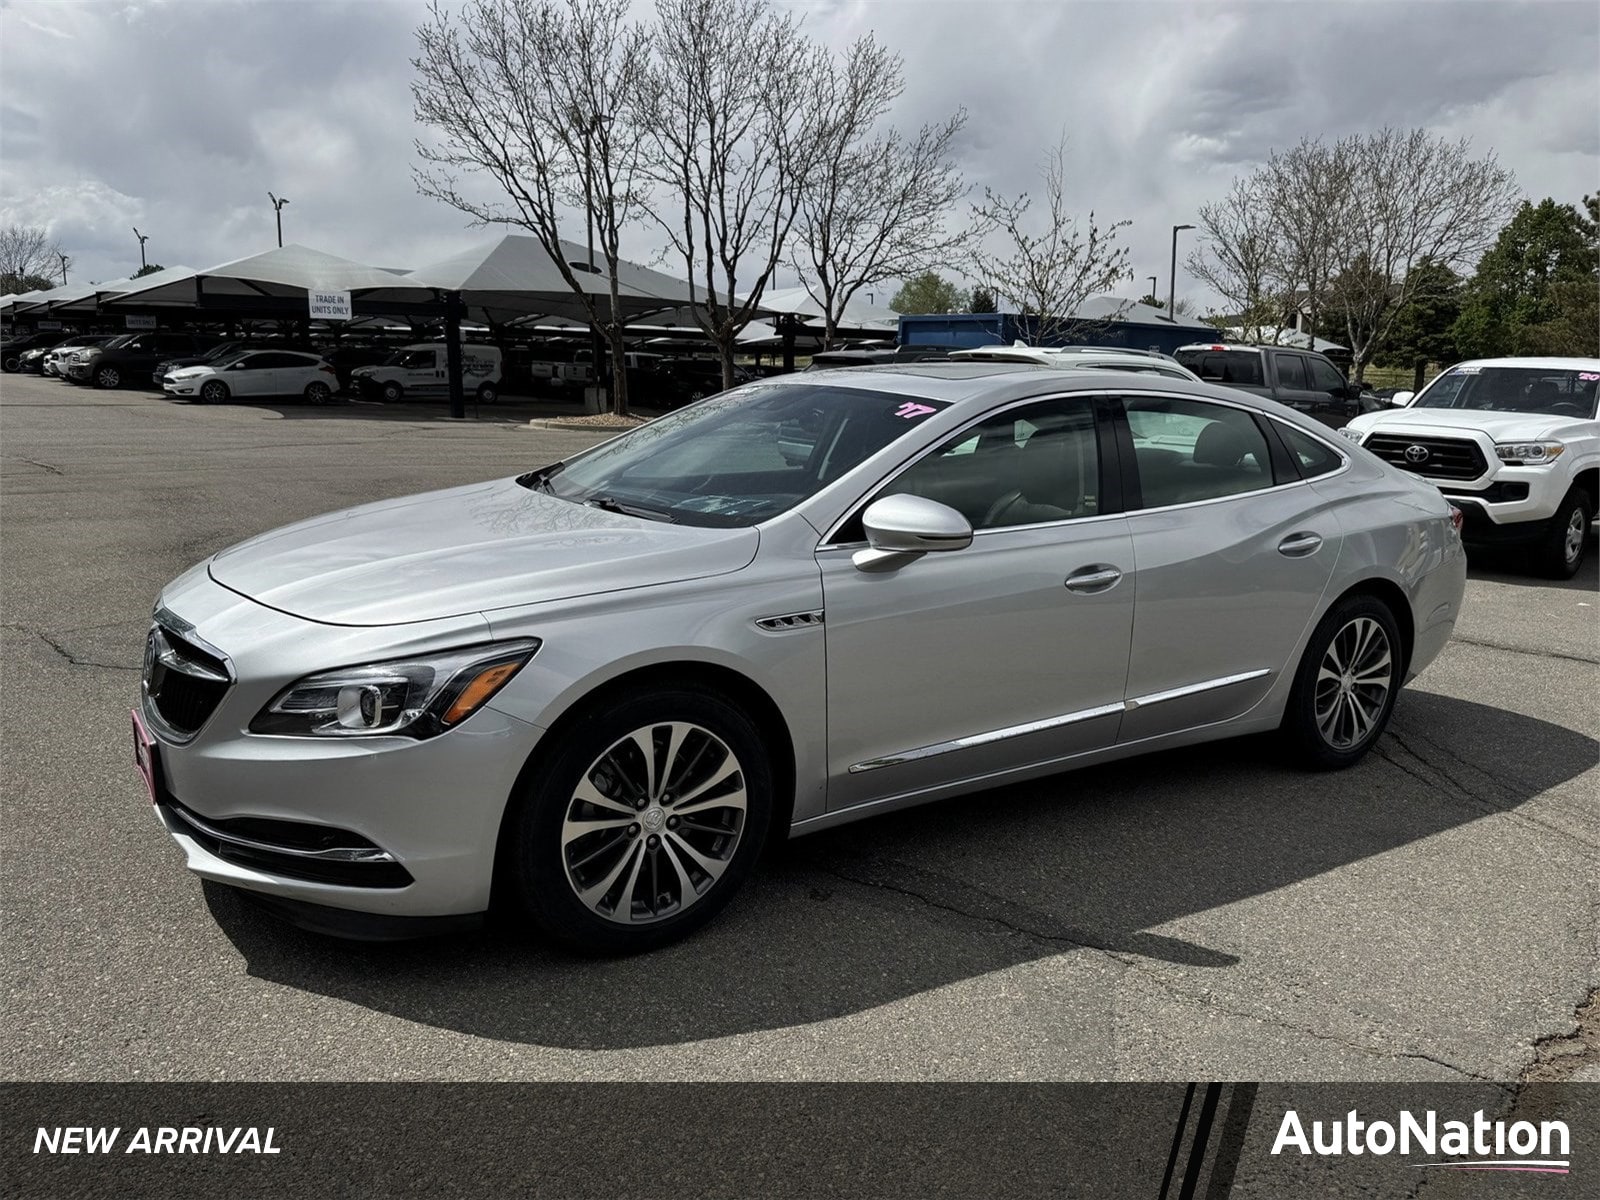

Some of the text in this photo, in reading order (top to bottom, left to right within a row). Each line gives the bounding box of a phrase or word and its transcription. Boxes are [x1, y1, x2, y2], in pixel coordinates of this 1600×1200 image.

[315, 294, 345, 304] TRADE IN
[311, 305, 349, 315] UNITS ONLY
[1578, 372, 1600, 381] 20
